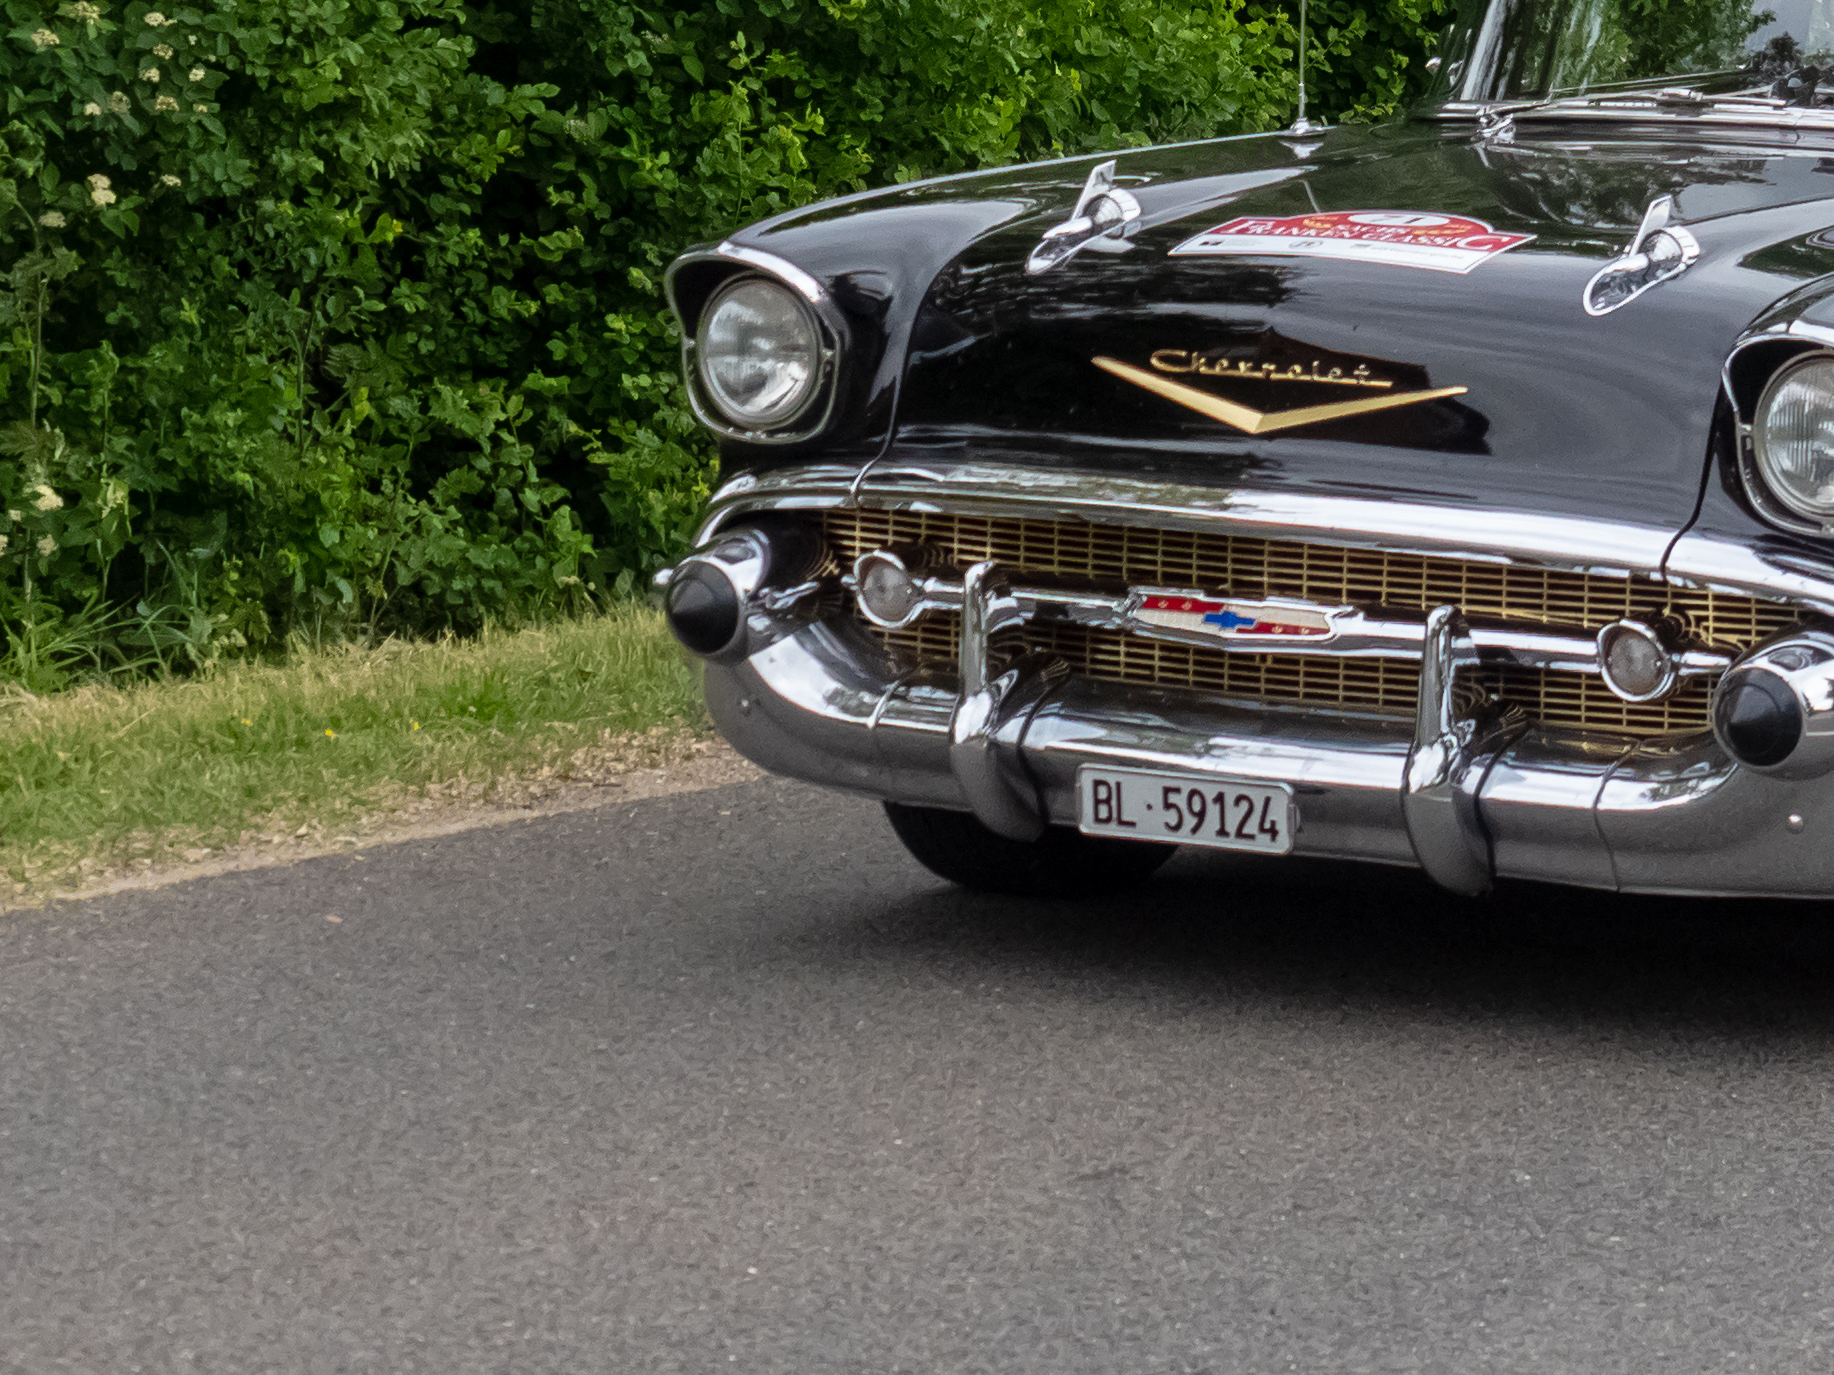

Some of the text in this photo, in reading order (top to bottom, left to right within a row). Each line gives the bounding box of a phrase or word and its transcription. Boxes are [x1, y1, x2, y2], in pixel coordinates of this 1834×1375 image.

[1150, 348, 1388, 386] Chevrolet
[1092, 779, 1280, 843] BL 59124
